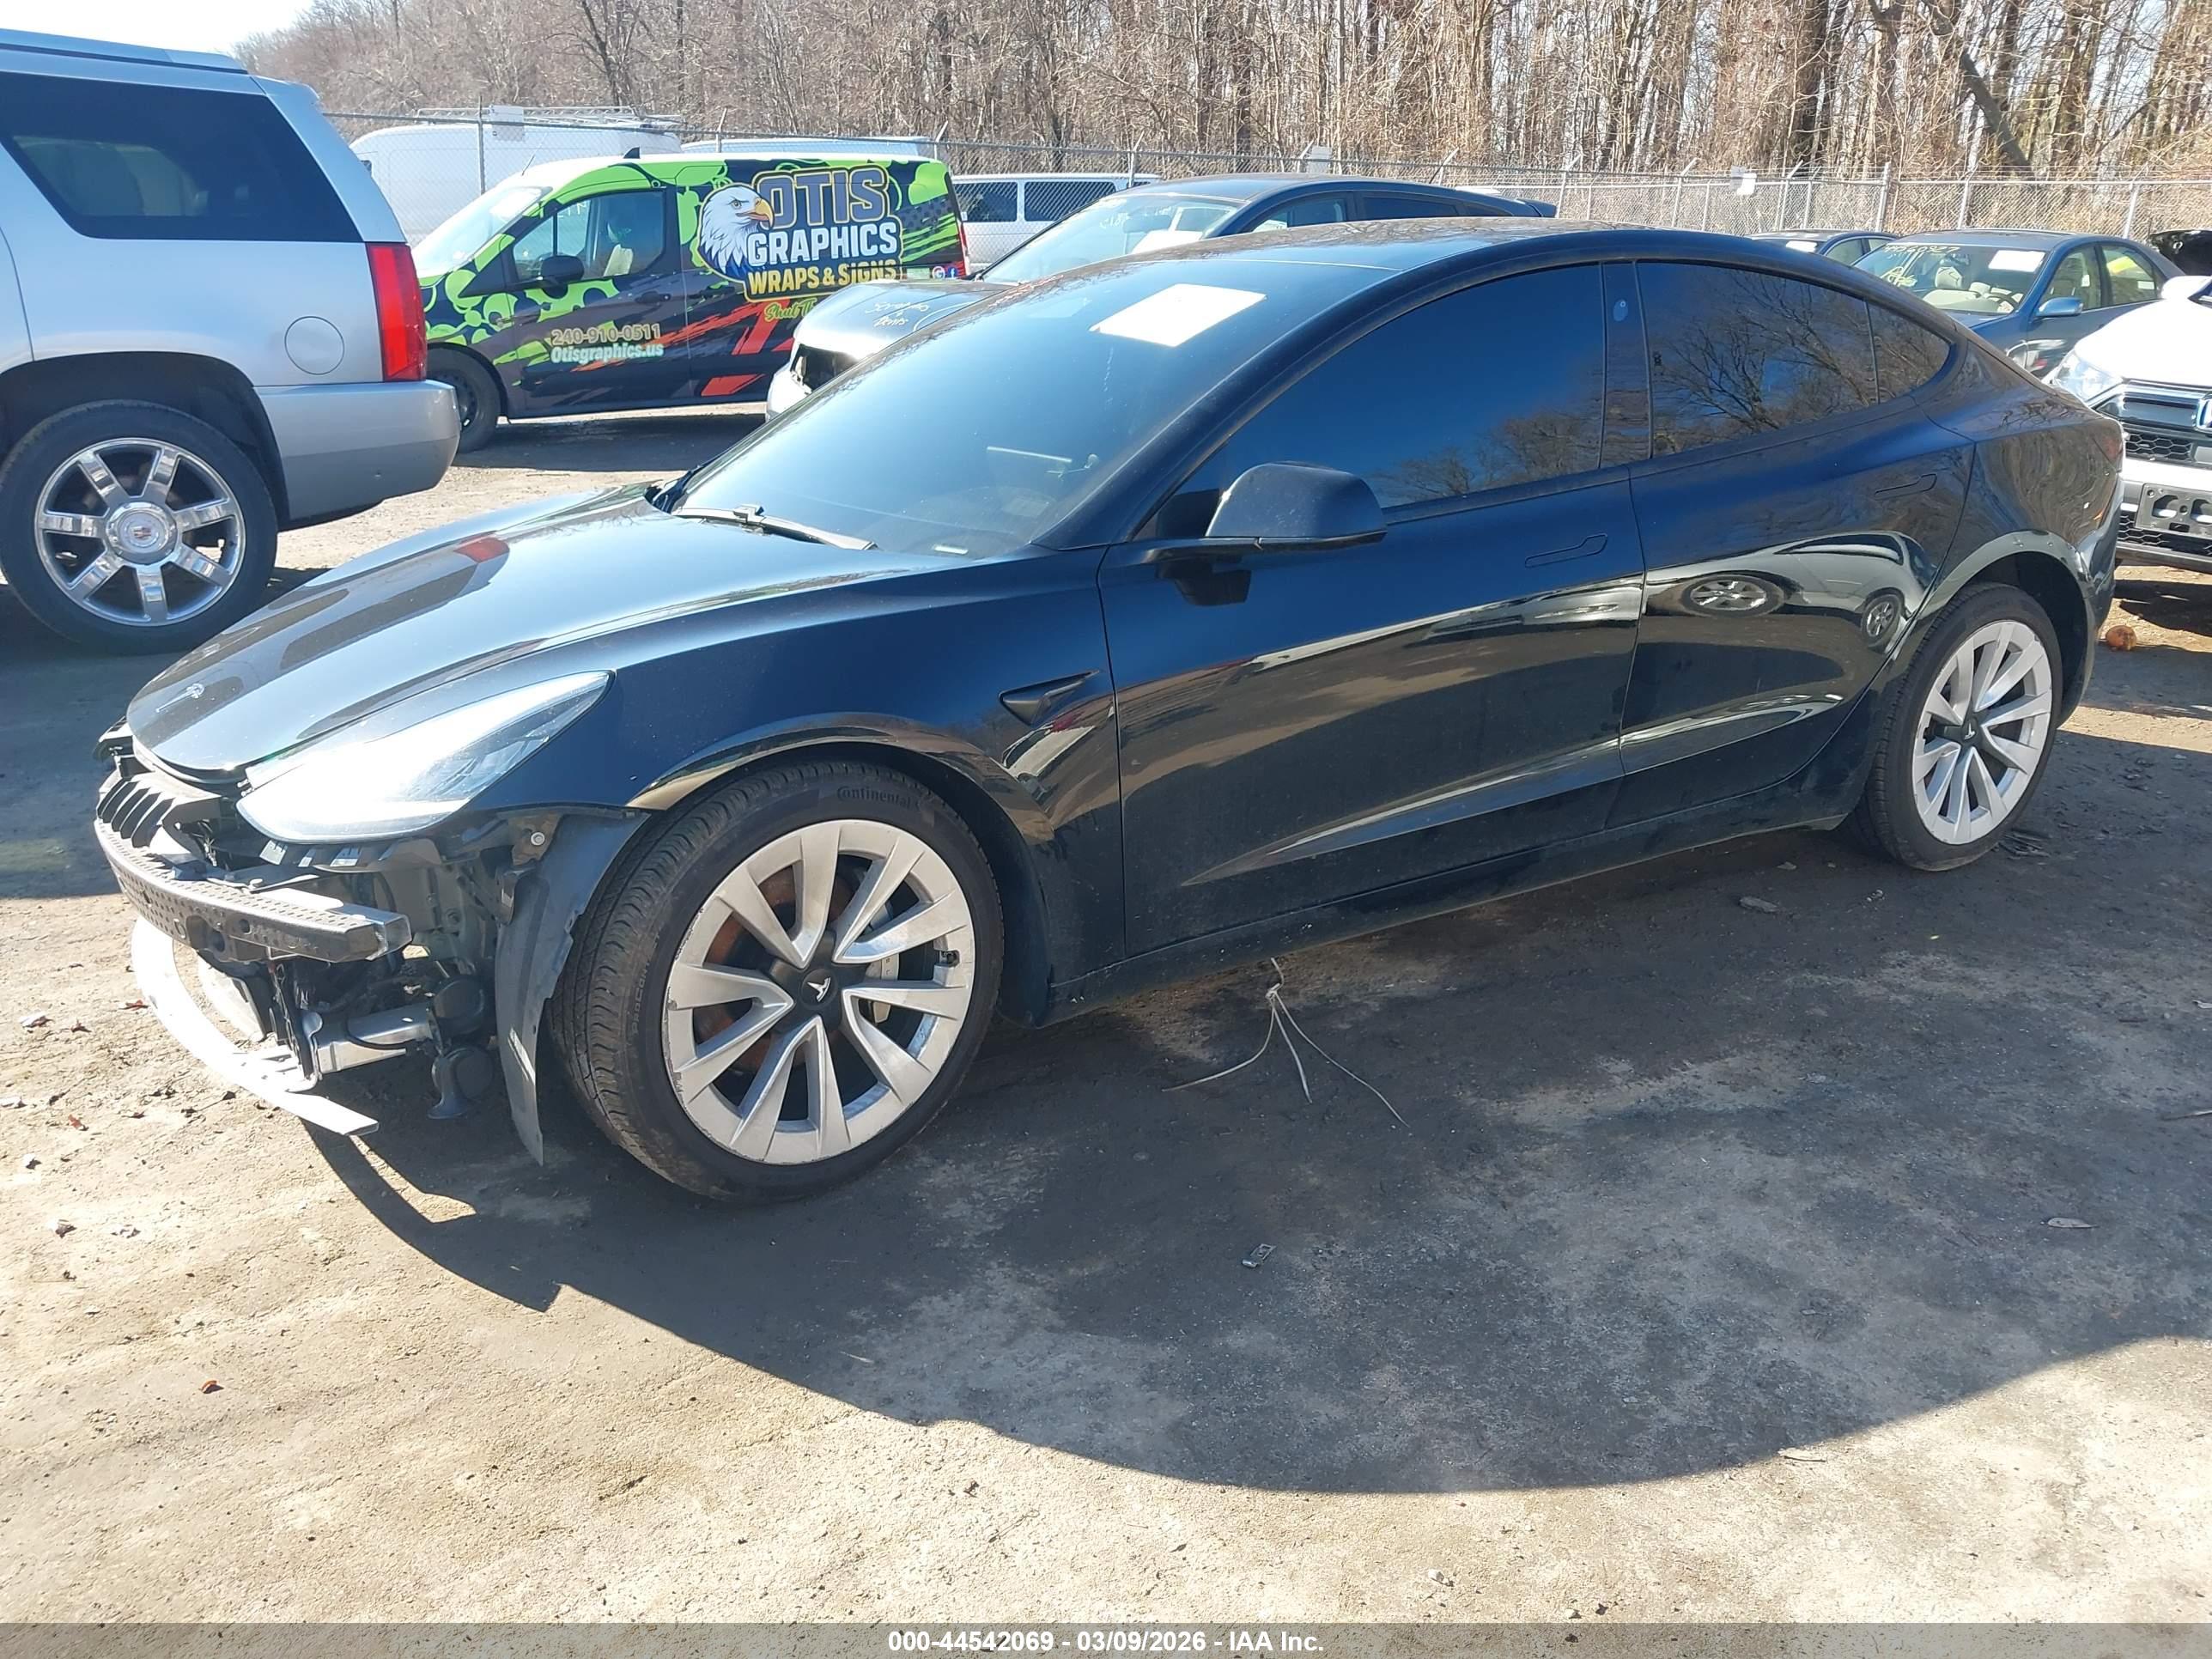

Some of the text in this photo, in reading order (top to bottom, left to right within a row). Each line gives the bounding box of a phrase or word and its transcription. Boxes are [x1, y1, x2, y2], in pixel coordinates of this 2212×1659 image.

[758, 167, 888, 230] OTIS
[746, 221, 898, 268] GRAPHICS
[747, 258, 897, 295] WRAPS & SIGNS
[764, 301, 801, 322] Shut
[551, 323, 660, 345] 240-910-0511
[550, 342, 664, 365] Otisgraphics.us
[837, 785, 911, 809] Continental
